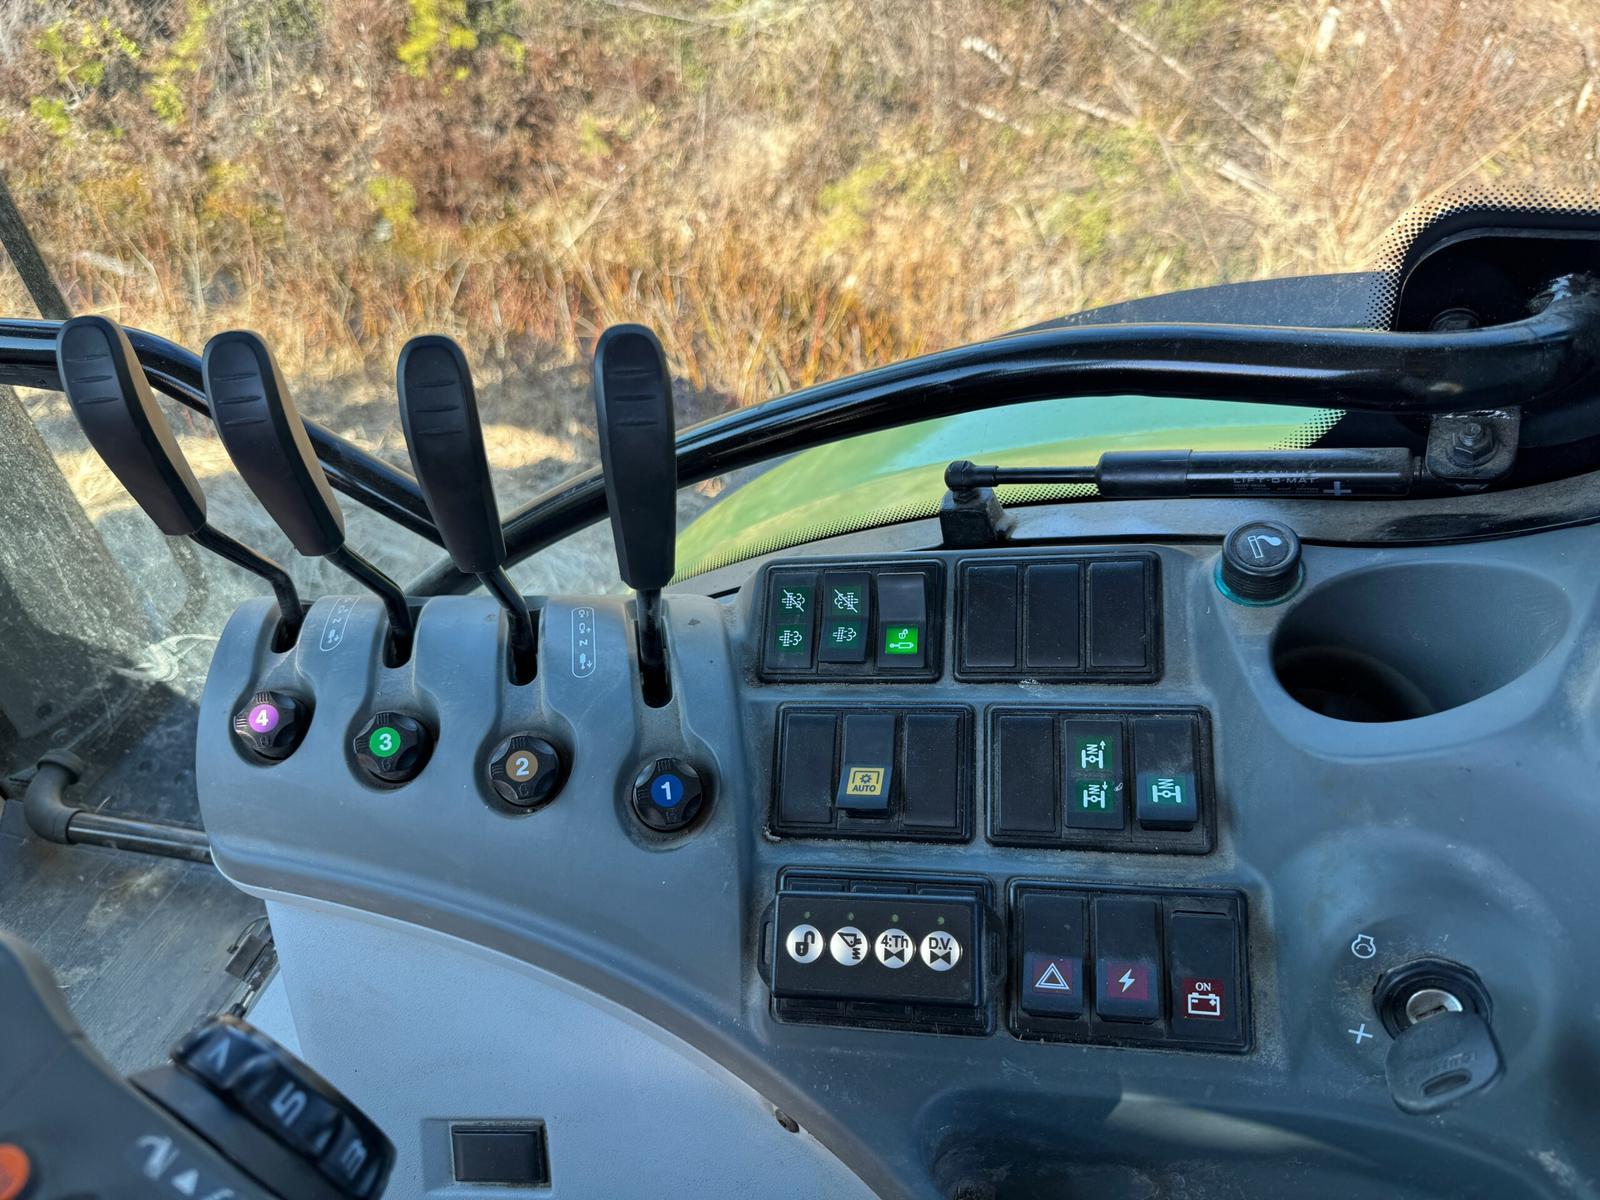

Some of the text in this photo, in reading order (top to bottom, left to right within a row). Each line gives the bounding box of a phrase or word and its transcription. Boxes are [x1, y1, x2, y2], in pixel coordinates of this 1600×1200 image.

[255, 709, 269, 726] 4
[379, 733, 392, 751] 3
[515, 757, 529, 776] 2
[660, 781, 672, 800] 1
[851, 784, 877, 793] AUTO
[880, 934, 909, 948] 4:Th
[928, 937, 953, 951] D.V.
[1195, 982, 1212, 992] ON
[271, 1082, 308, 1127] 5
